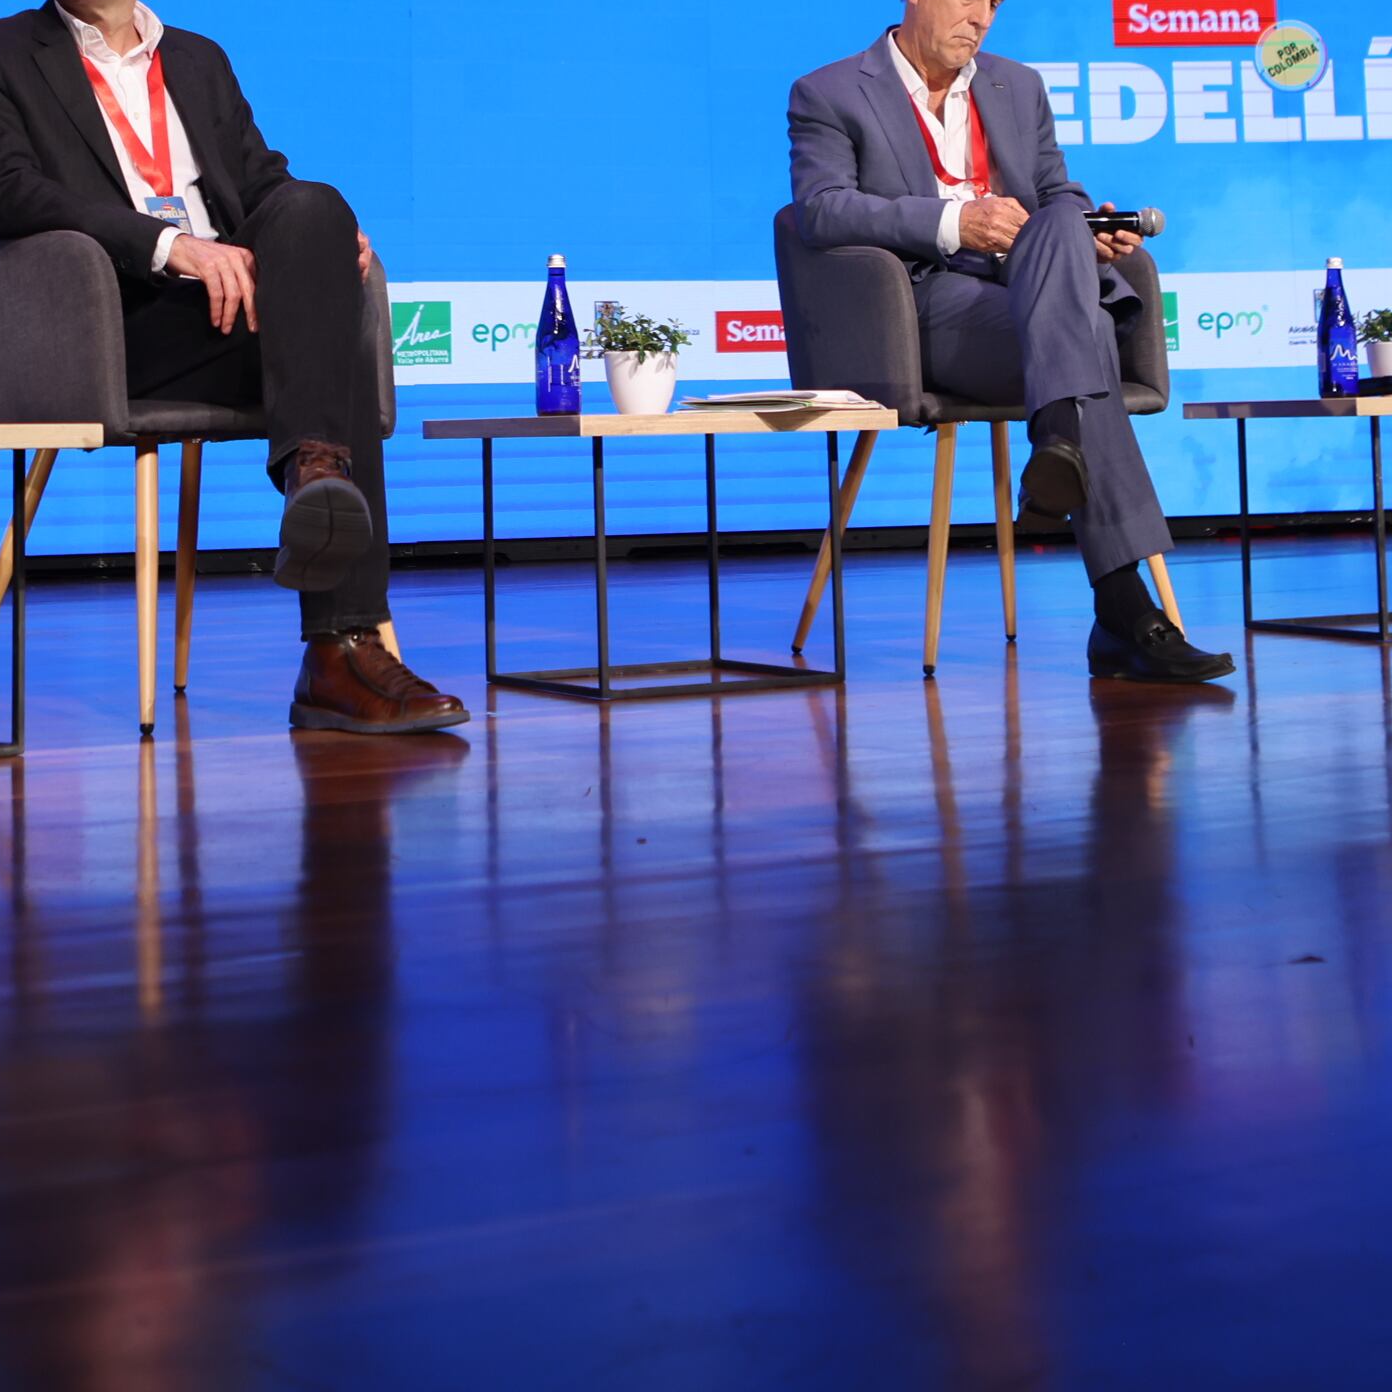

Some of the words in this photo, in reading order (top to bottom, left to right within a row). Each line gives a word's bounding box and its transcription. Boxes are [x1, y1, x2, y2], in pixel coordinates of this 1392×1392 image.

[1128, 3, 1262, 34] Semana
[1268, 43, 1319, 78] COLOMBIA
[1277, 41, 1299, 60] POR
[1197, 311, 1264, 339] epm
